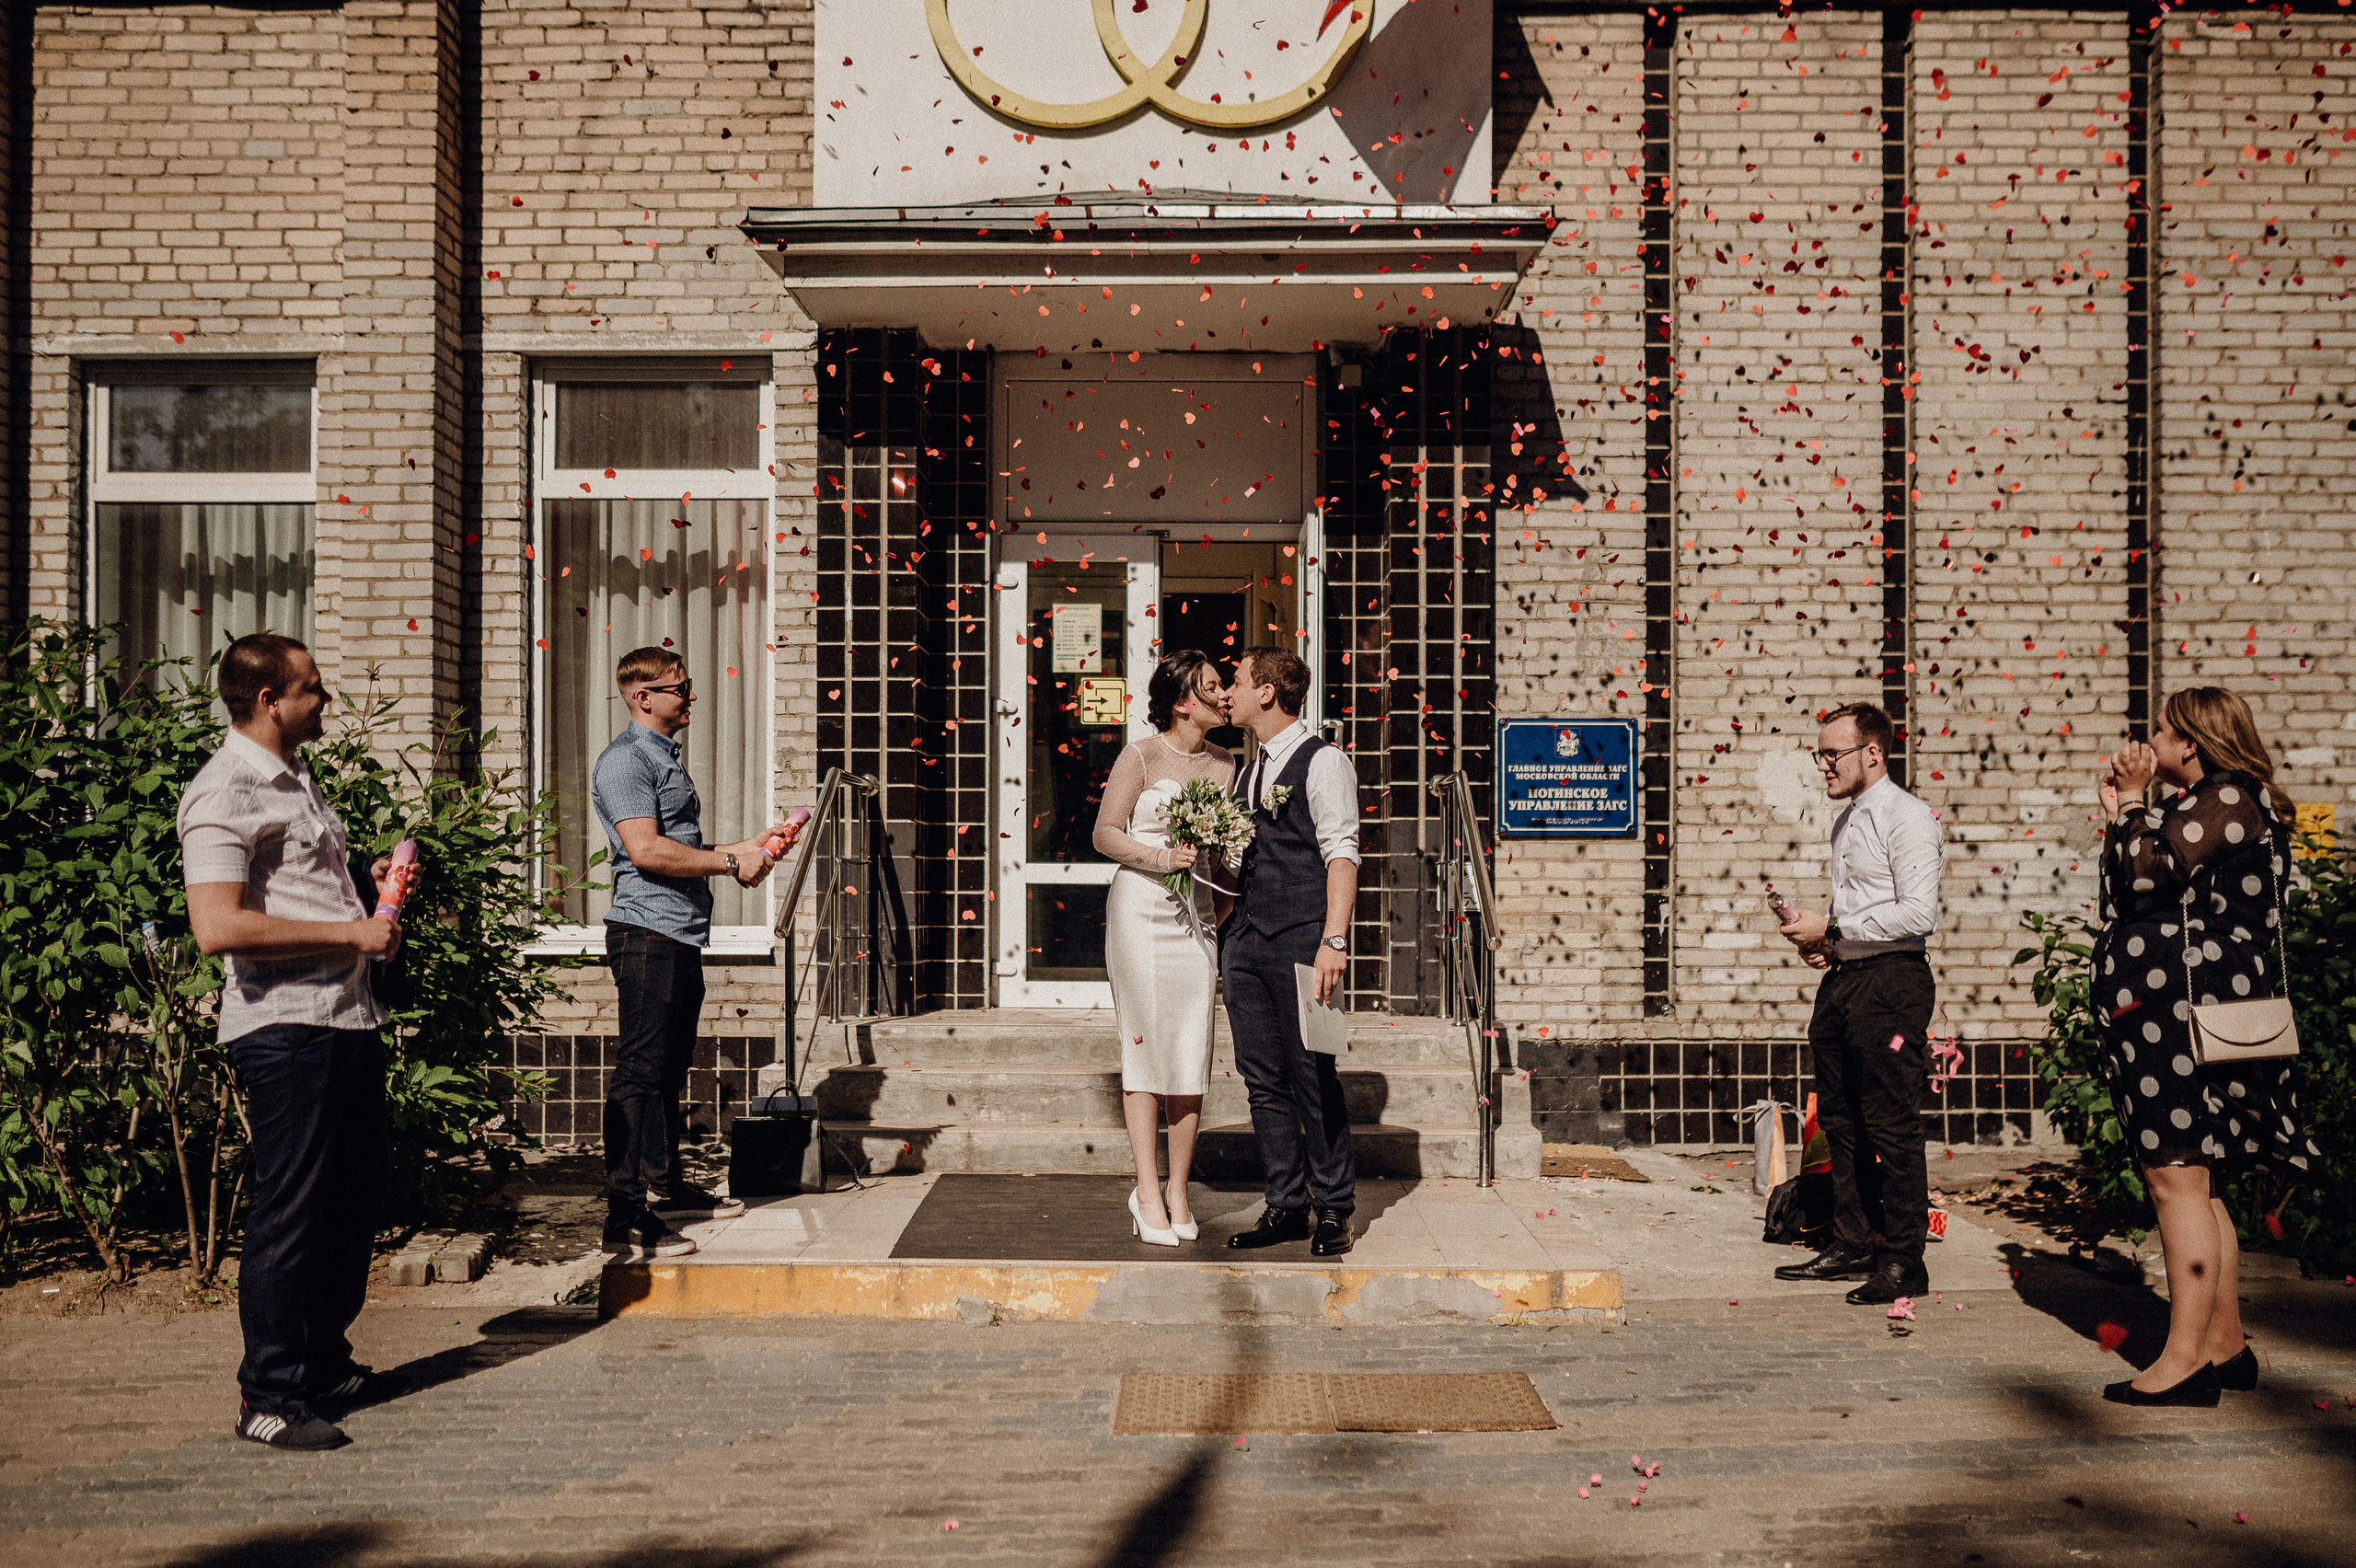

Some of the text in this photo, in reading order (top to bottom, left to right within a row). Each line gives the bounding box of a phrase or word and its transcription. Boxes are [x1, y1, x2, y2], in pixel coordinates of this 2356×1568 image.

[1528, 788, 1608, 799] НОГИНСКОЕ
[1508, 801, 1628, 811] УПРАВЛЕНИЕ ЗАГС
